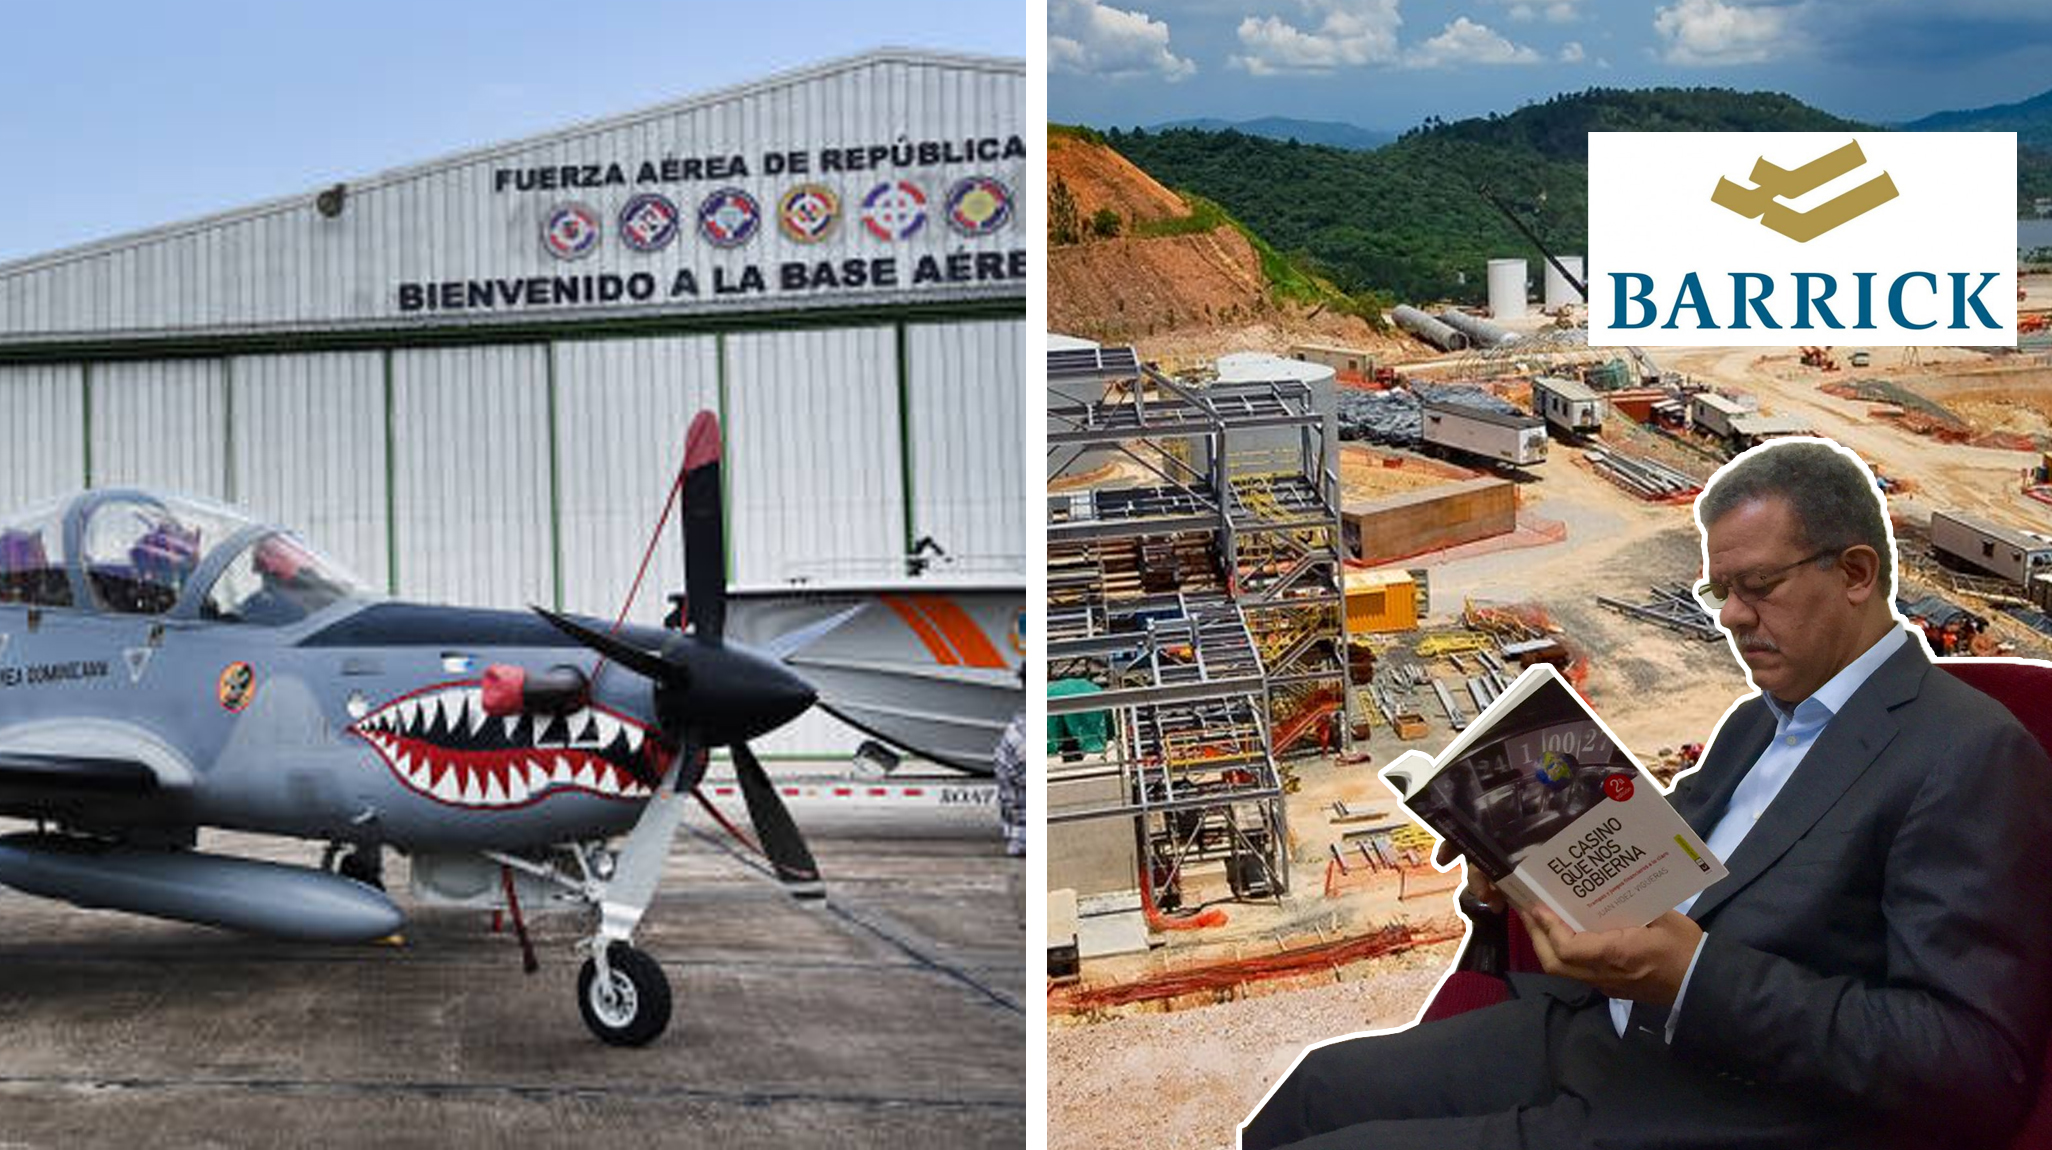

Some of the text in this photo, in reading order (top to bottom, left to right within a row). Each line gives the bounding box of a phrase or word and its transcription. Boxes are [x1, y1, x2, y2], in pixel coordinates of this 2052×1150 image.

[495, 135, 1026, 192] FUERZA AÉREA DE REPÚBLICA
[399, 272, 655, 311] BIENVENIDO
[671, 268, 699, 297] A
[713, 265, 765, 294] LA
[780, 257, 898, 290] BASE
[1547, 817, 1622, 875] EL CASINO
[1560, 839, 1622, 886] QUE NOS
[1572, 845, 1647, 899] GOBIERNA
[1634, 866, 1668, 893] VIGUERAS
